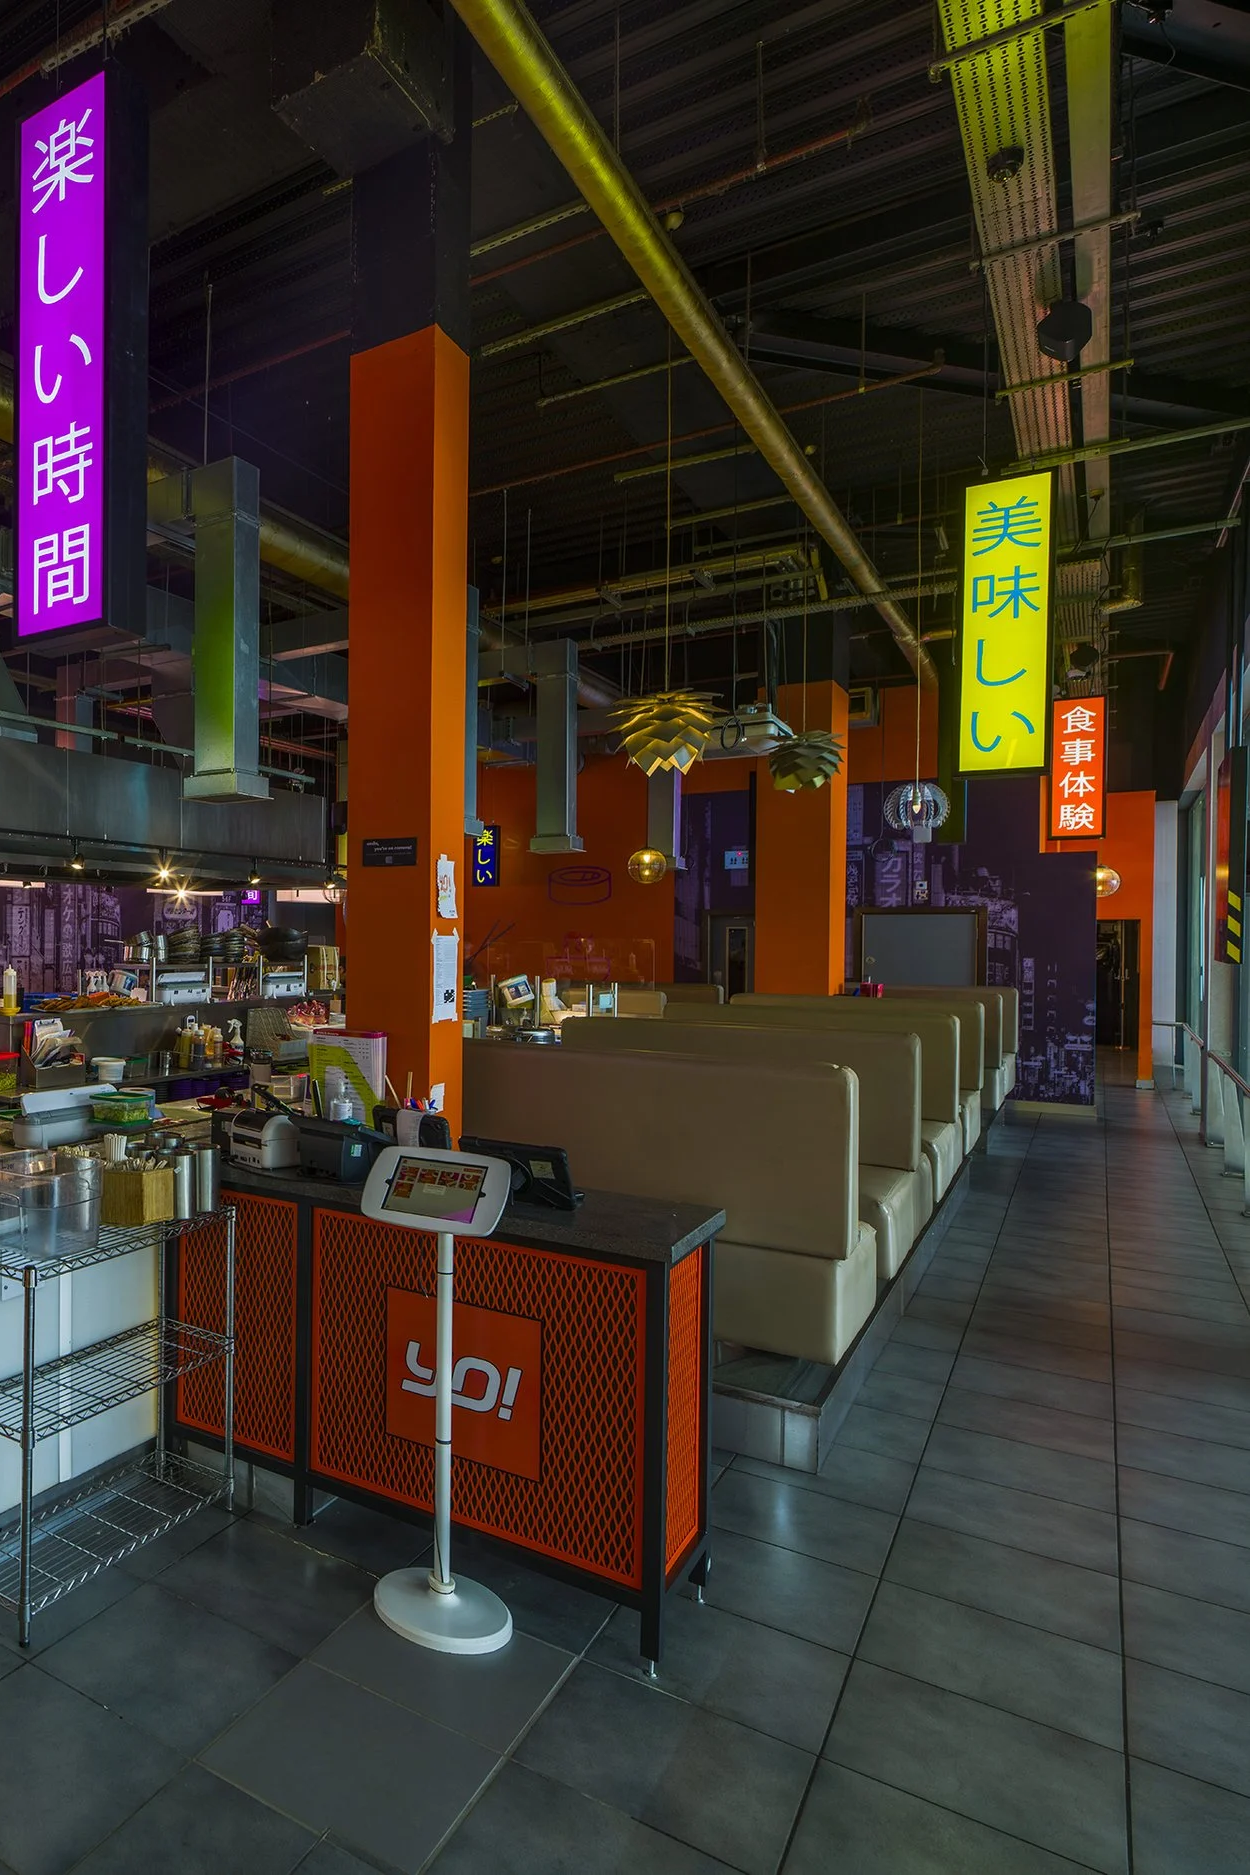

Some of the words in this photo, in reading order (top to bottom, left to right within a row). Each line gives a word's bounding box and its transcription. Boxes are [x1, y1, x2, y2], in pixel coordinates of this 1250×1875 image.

[31, 108, 94, 615] 楽しい時間
[971, 496, 1042, 752] 美味しい
[1058, 705, 1096, 831] 食事体験
[476, 829, 493, 883] 楽しい
[400, 1340, 522, 1422] YO!
